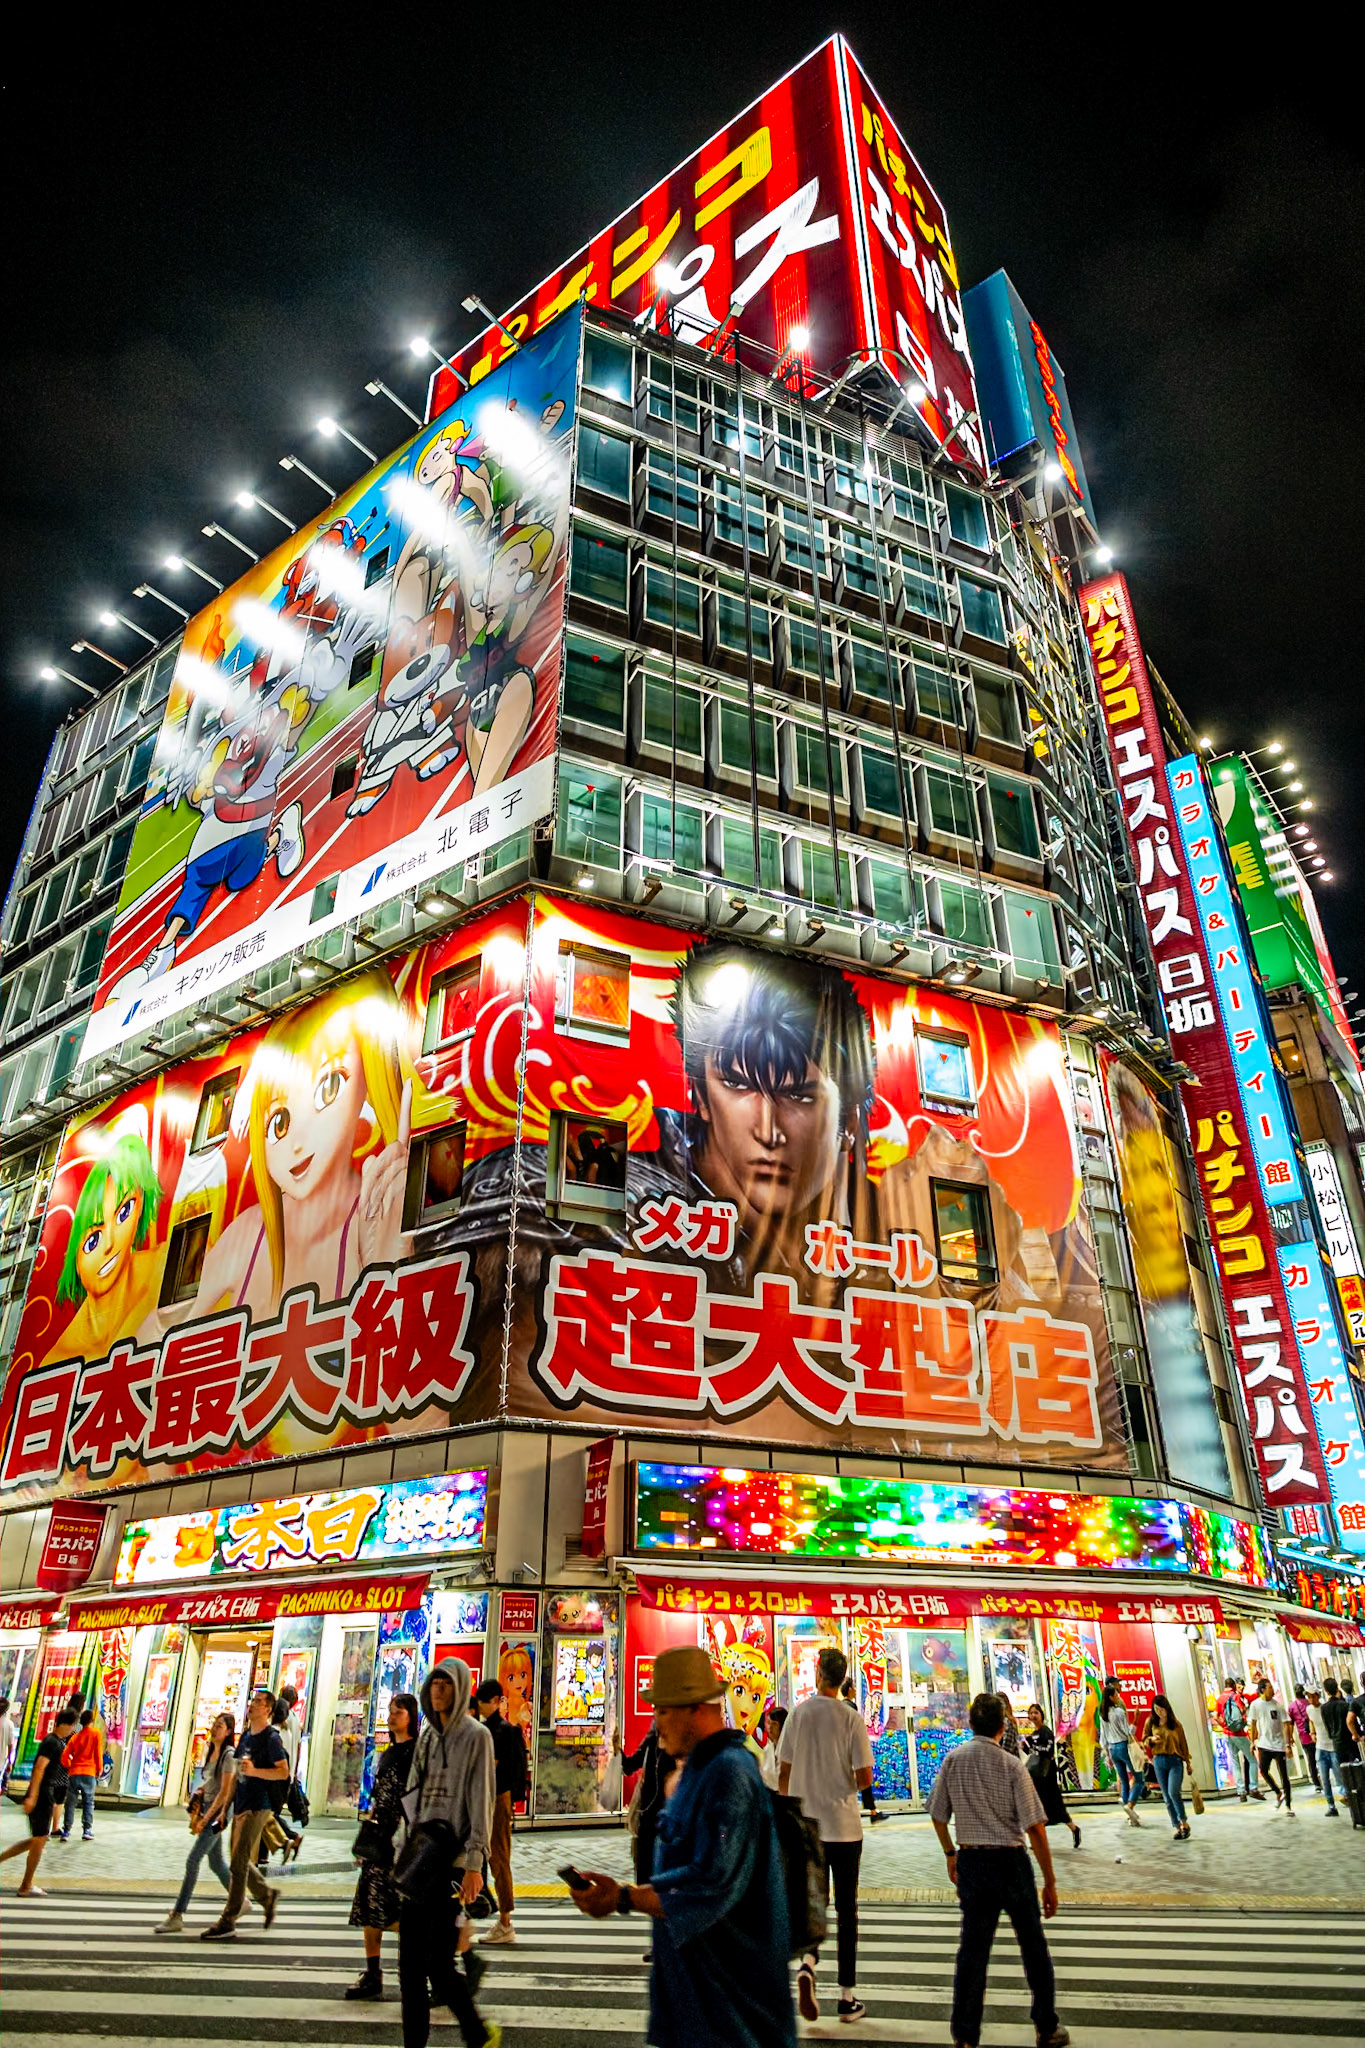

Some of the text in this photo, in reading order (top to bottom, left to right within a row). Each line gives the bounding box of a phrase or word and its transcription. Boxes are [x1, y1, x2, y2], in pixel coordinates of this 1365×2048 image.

[861, 102, 959, 290] パチンコ
[437, 788, 524, 855] 北電子
[1086, 587, 1216, 1034] パチンコ エスパス 日拓
[176, 930, 268, 994] キタック販売
[637, 1199, 936, 1286] メガ ホール
[1312, 1163, 1349, 1258] 小松ビル
[1196, 1109, 1319, 1493] パチンコ エスパス
[3, 1255, 471, 1486] 日本最大級
[543, 1252, 1101, 1445] 超大型店
[49, 1536, 94, 1551] エスパス
[223, 1492, 385, 1568] 本日
[77, 1607, 130, 1628] PACHINKO
[136, 1603, 167, 1624] SLOT
[276, 1588, 354, 1616] PACHINKO
[353, 1593, 363, 1607] &
[365, 1586, 406, 1609] SLOT
[504, 1608, 533, 1619] エスパス
[858, 1619, 887, 1695] 本日
[1055, 1628, 1083, 1694] 本日
[1119, 1677, 1155, 1692] エスパス
